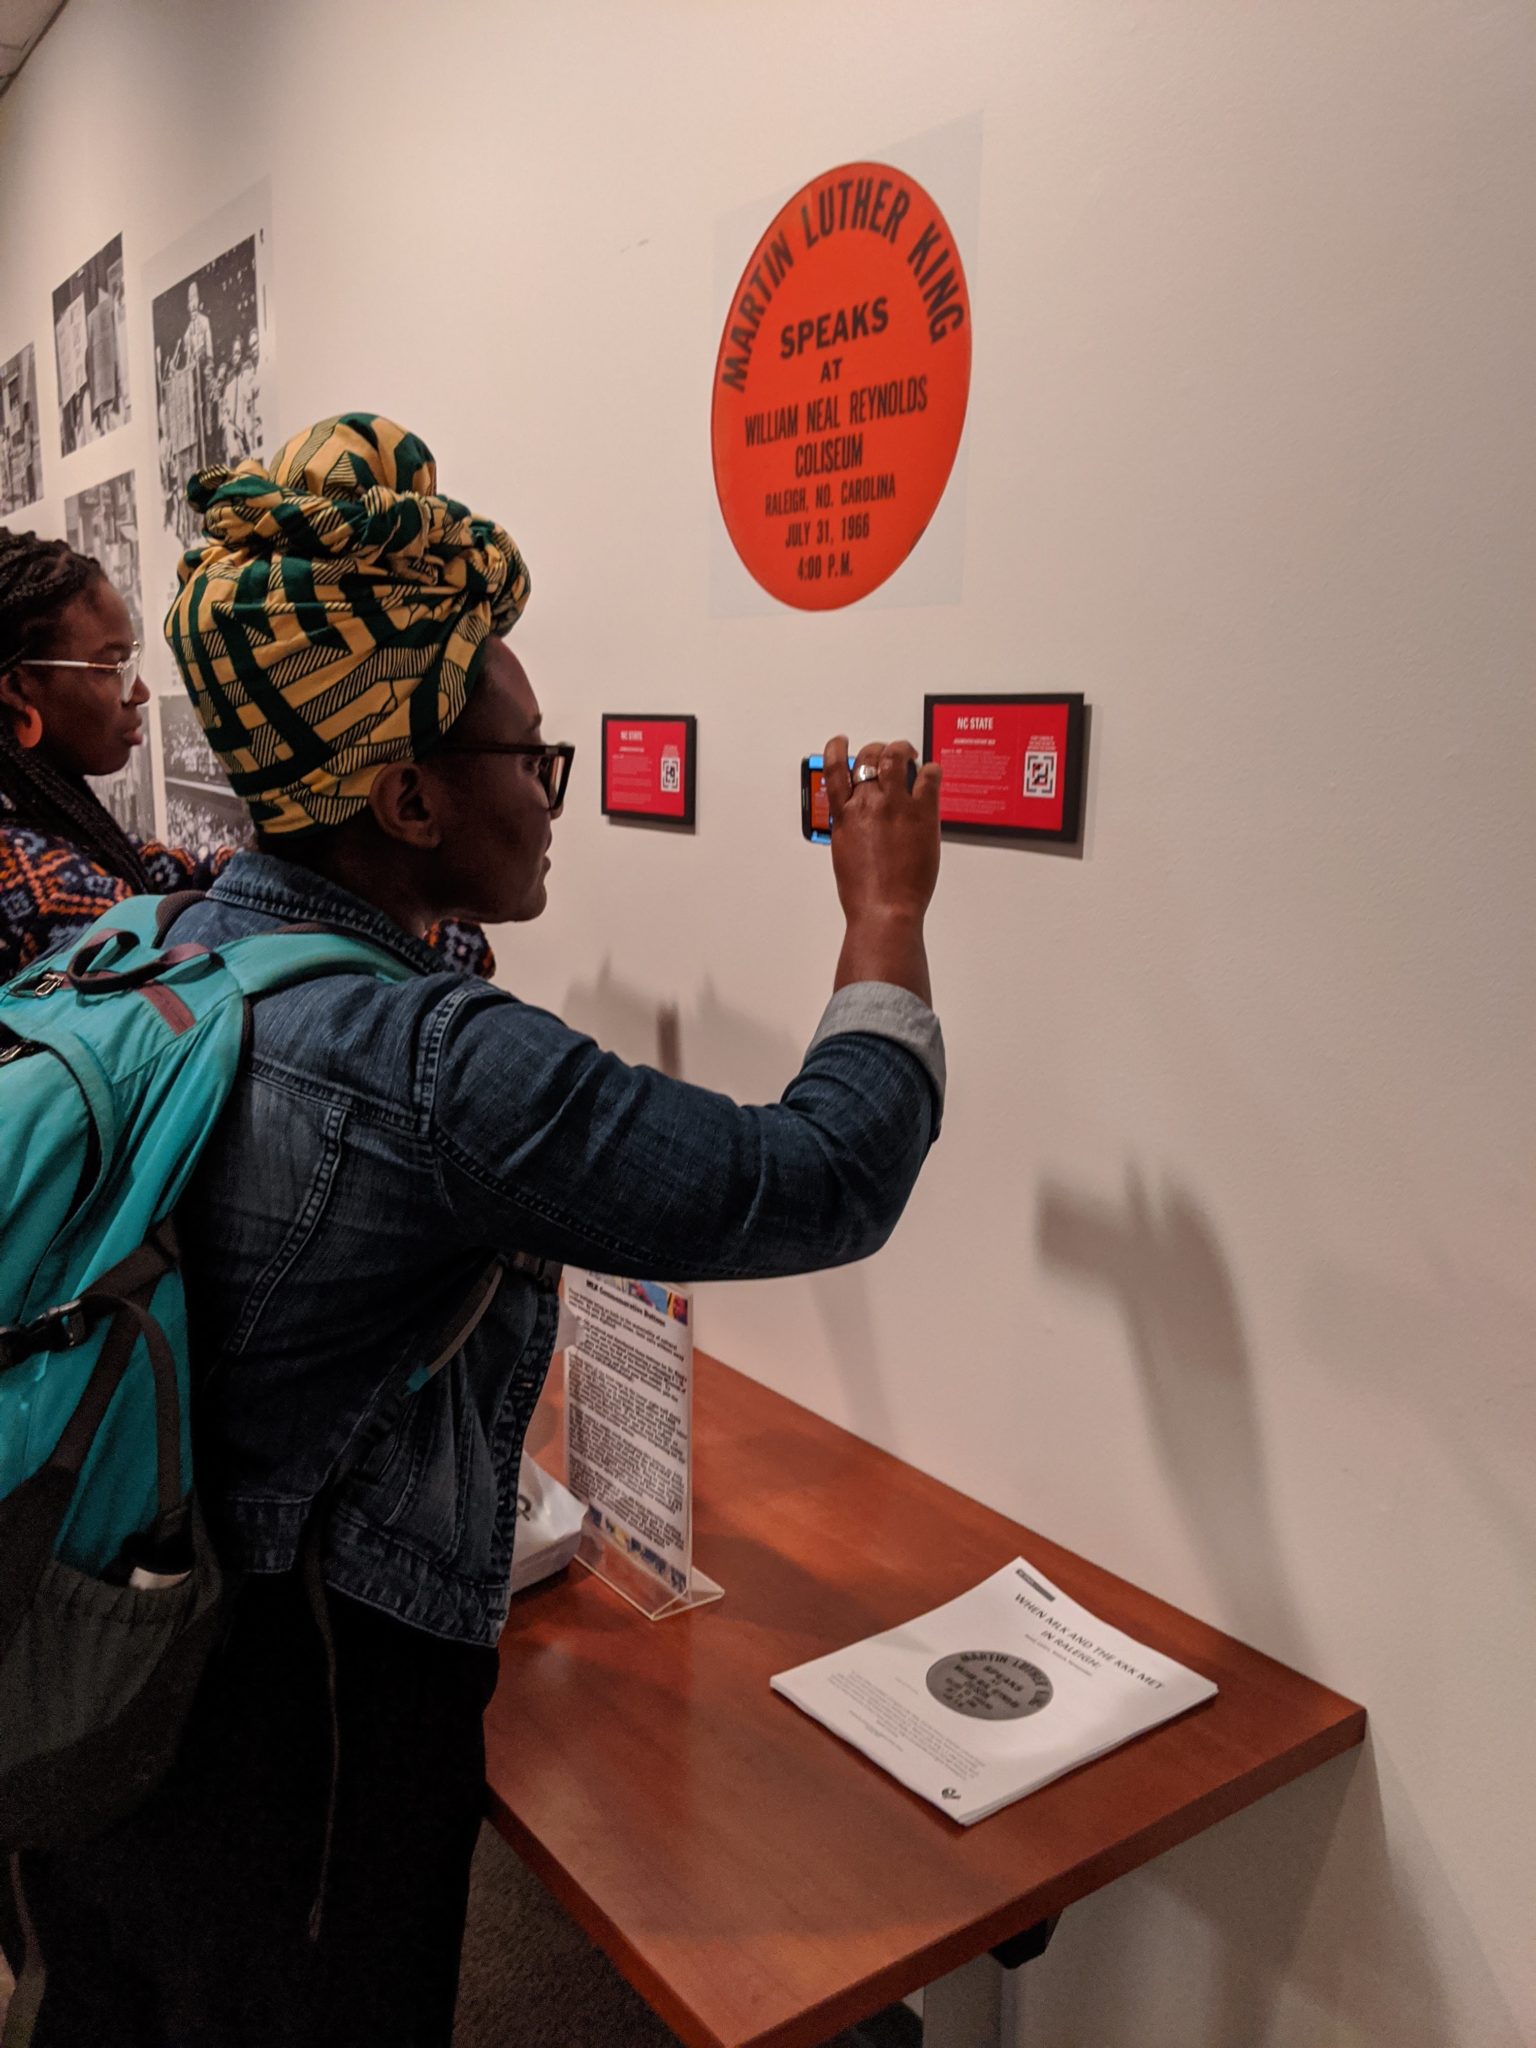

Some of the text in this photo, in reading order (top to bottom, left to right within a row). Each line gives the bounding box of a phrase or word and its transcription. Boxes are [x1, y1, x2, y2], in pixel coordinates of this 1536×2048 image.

[721, 176, 964, 394] MARTIN LUTHER KING
[780, 297, 889, 359] SPEAKS
[820, 357, 842, 383] AT
[745, 375, 928, 447] WILLIAM NEAL REYNOLDS
[795, 434, 863, 478] COLISEUM
[765, 473, 896, 517] RALEIGH, NO. CAROLINA
[785, 513, 870, 548] JULY 31, 1966
[797, 551, 853, 581] 4:00 P.M.
[957, 717, 993, 730] NC STATE
[1015, 1593, 1047, 1619] WHEN
[1045, 1616, 1070, 1635] MLK
[1067, 1631, 1093, 1649] AND
[1093, 1645, 1116, 1662] THE
[1114, 1657, 1139, 1675] KKK
[1137, 1670, 1165, 1690] MET
[1041, 1630, 1055, 1641] IN
